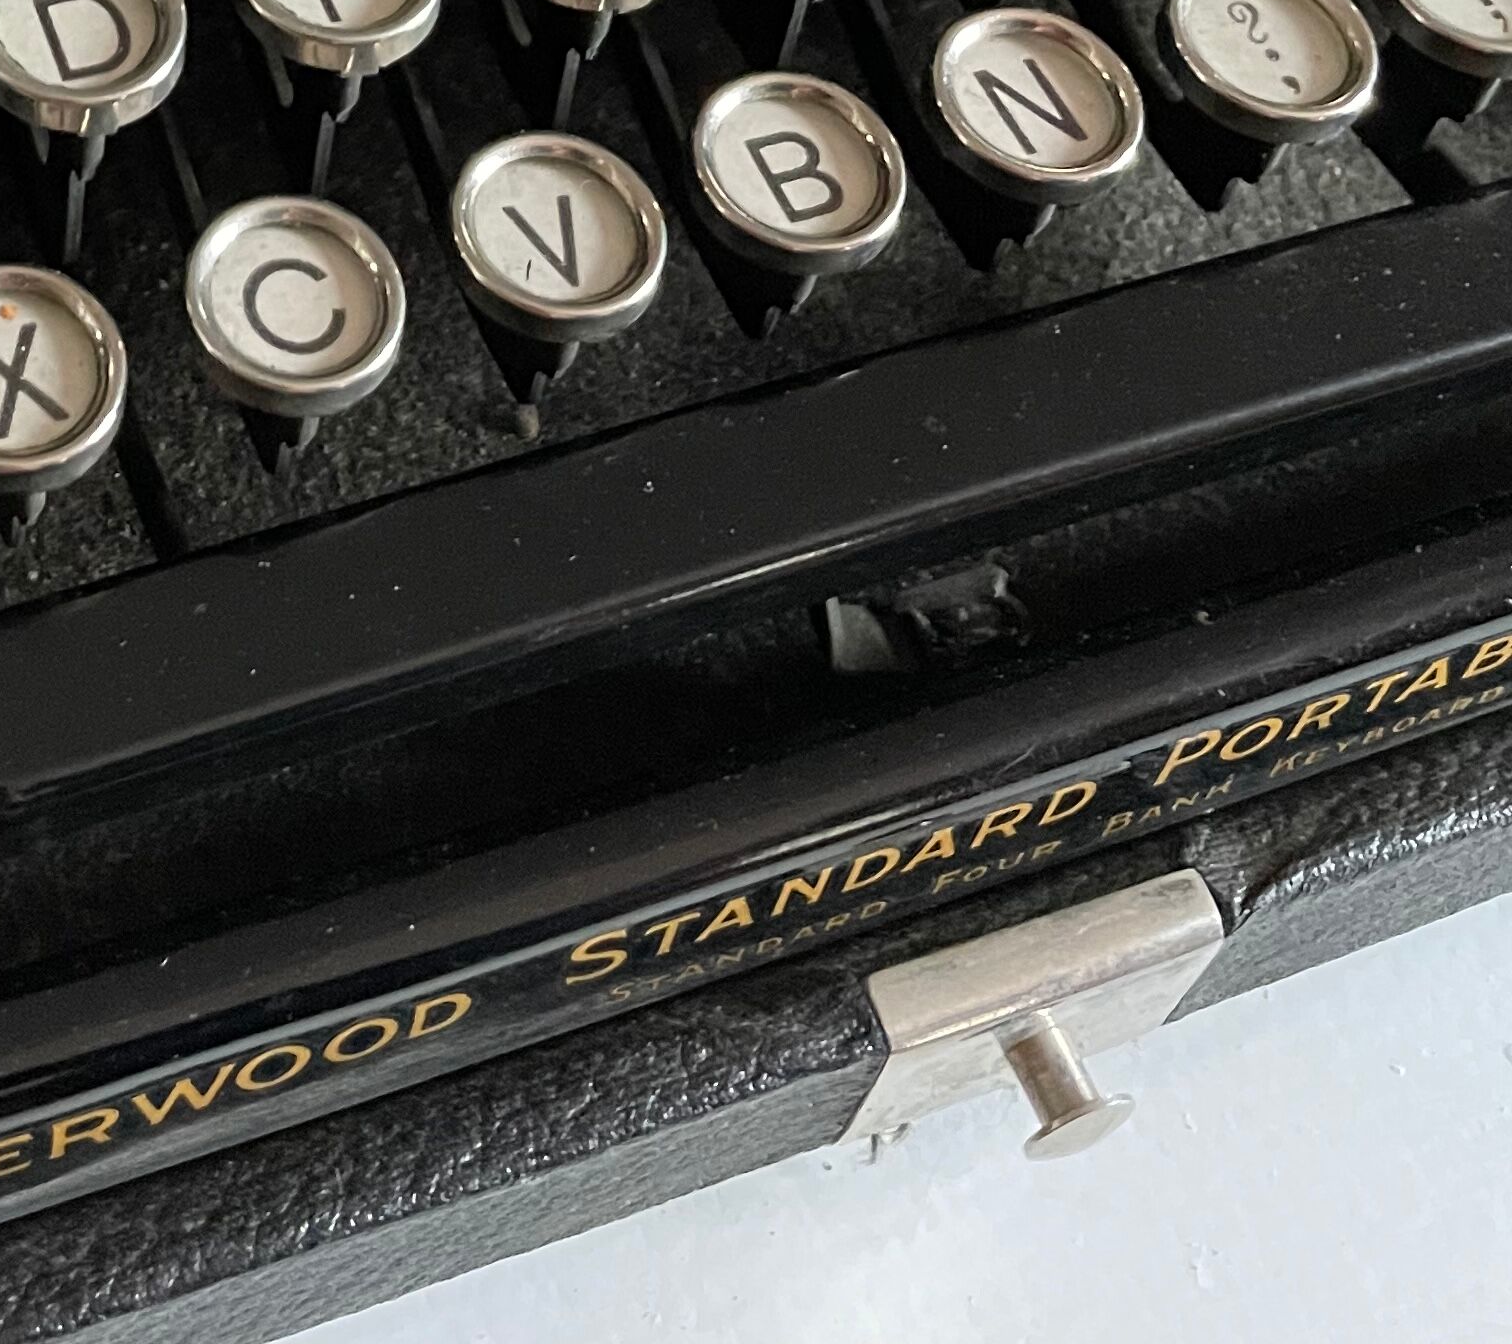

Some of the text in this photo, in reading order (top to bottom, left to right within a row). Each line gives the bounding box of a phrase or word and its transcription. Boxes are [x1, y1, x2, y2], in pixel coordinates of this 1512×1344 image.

[974, 57, 1088, 155] N
[746, 130, 844, 223] B
[501, 194, 581, 288] V
[242, 258, 348, 355] C
[565, 780, 1098, 986] STANDARD
[1153, 635, 1512, 787] PORTAB
[607, 685, 1505, 1002] STANDARD FOUR BANK KEYBOARD
